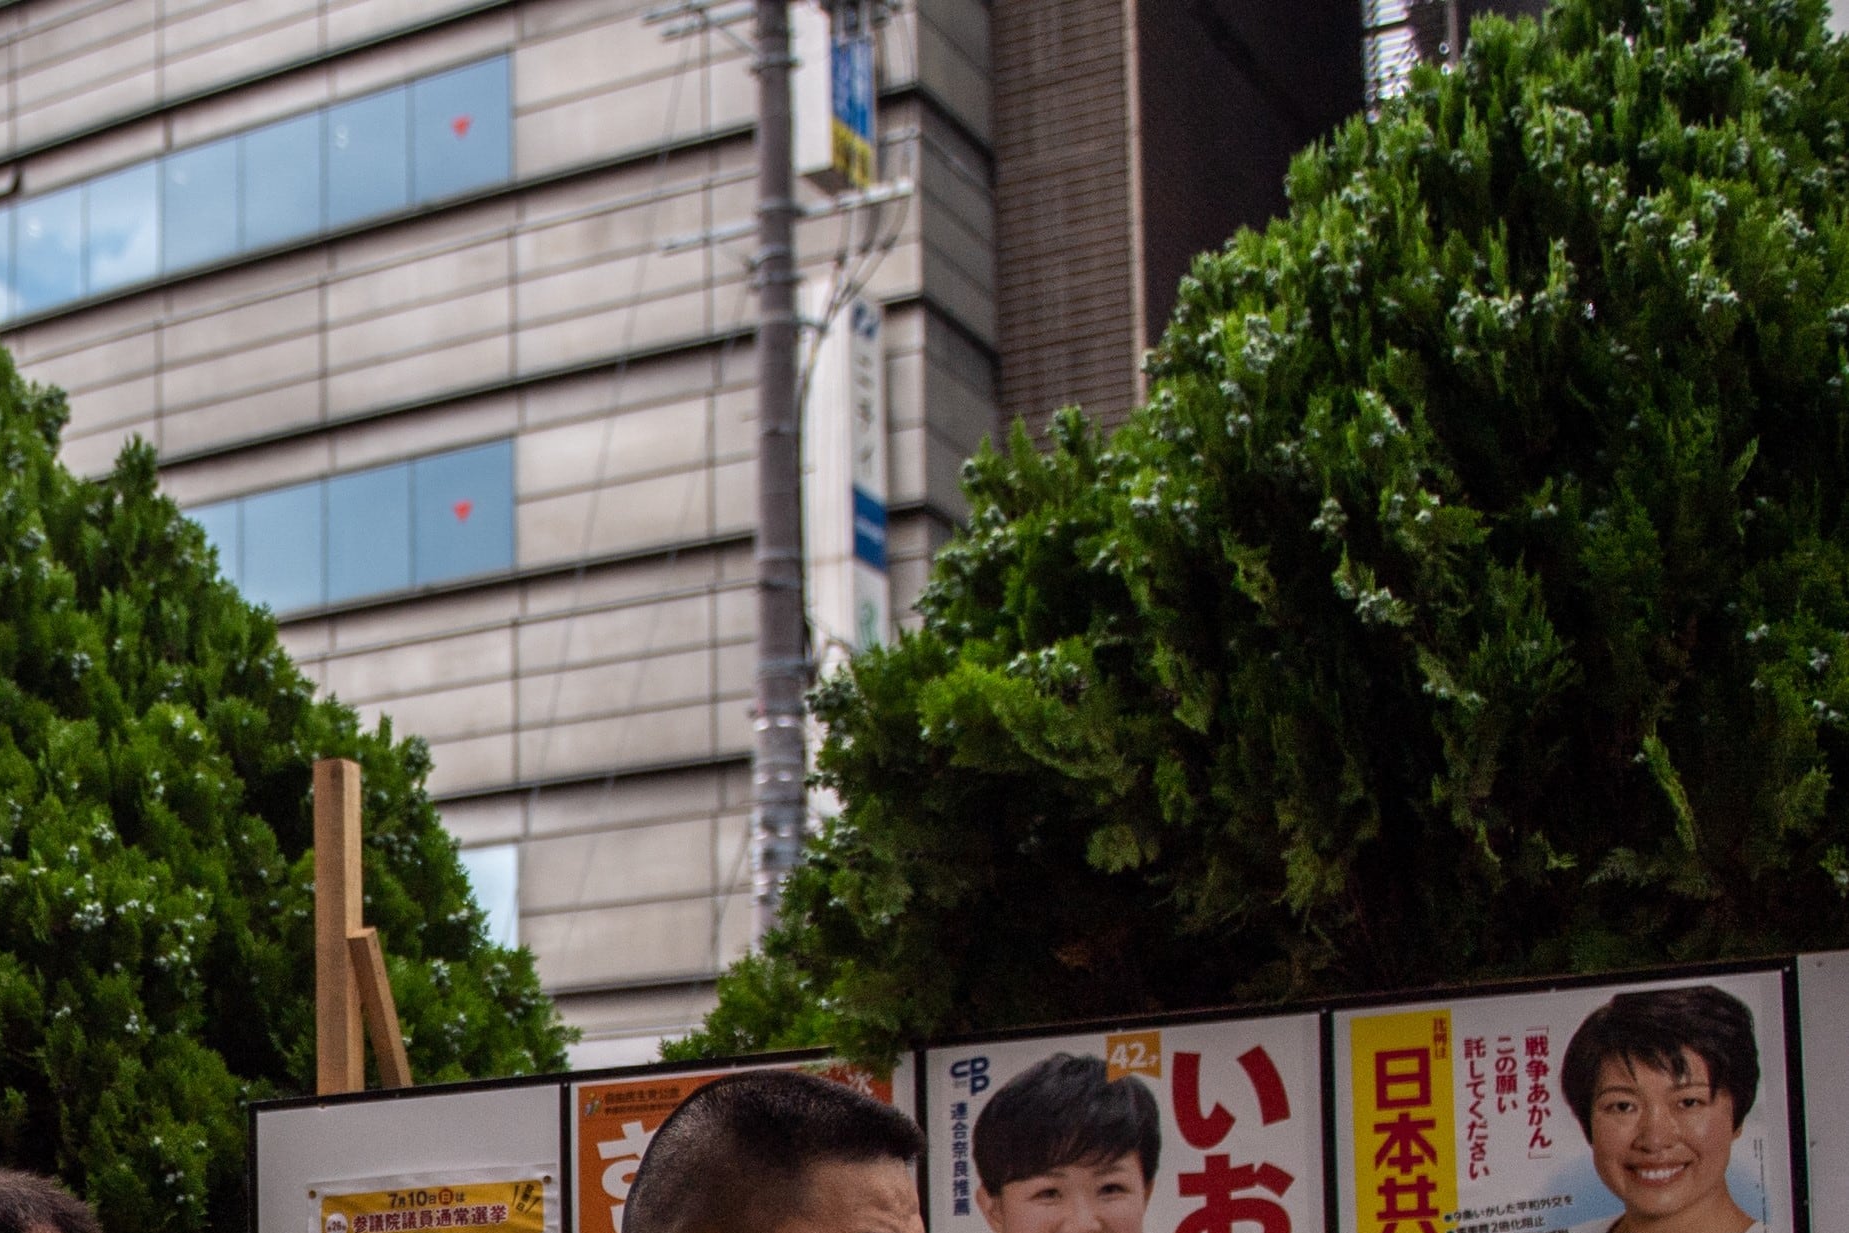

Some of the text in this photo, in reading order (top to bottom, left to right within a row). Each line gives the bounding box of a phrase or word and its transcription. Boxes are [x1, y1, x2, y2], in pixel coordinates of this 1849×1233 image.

[1463, 1036, 1491, 1181] 託してください
[1494, 1036, 1519, 1113] この願い
[1525, 1024, 1552, 1160] 「戦争あかん」
